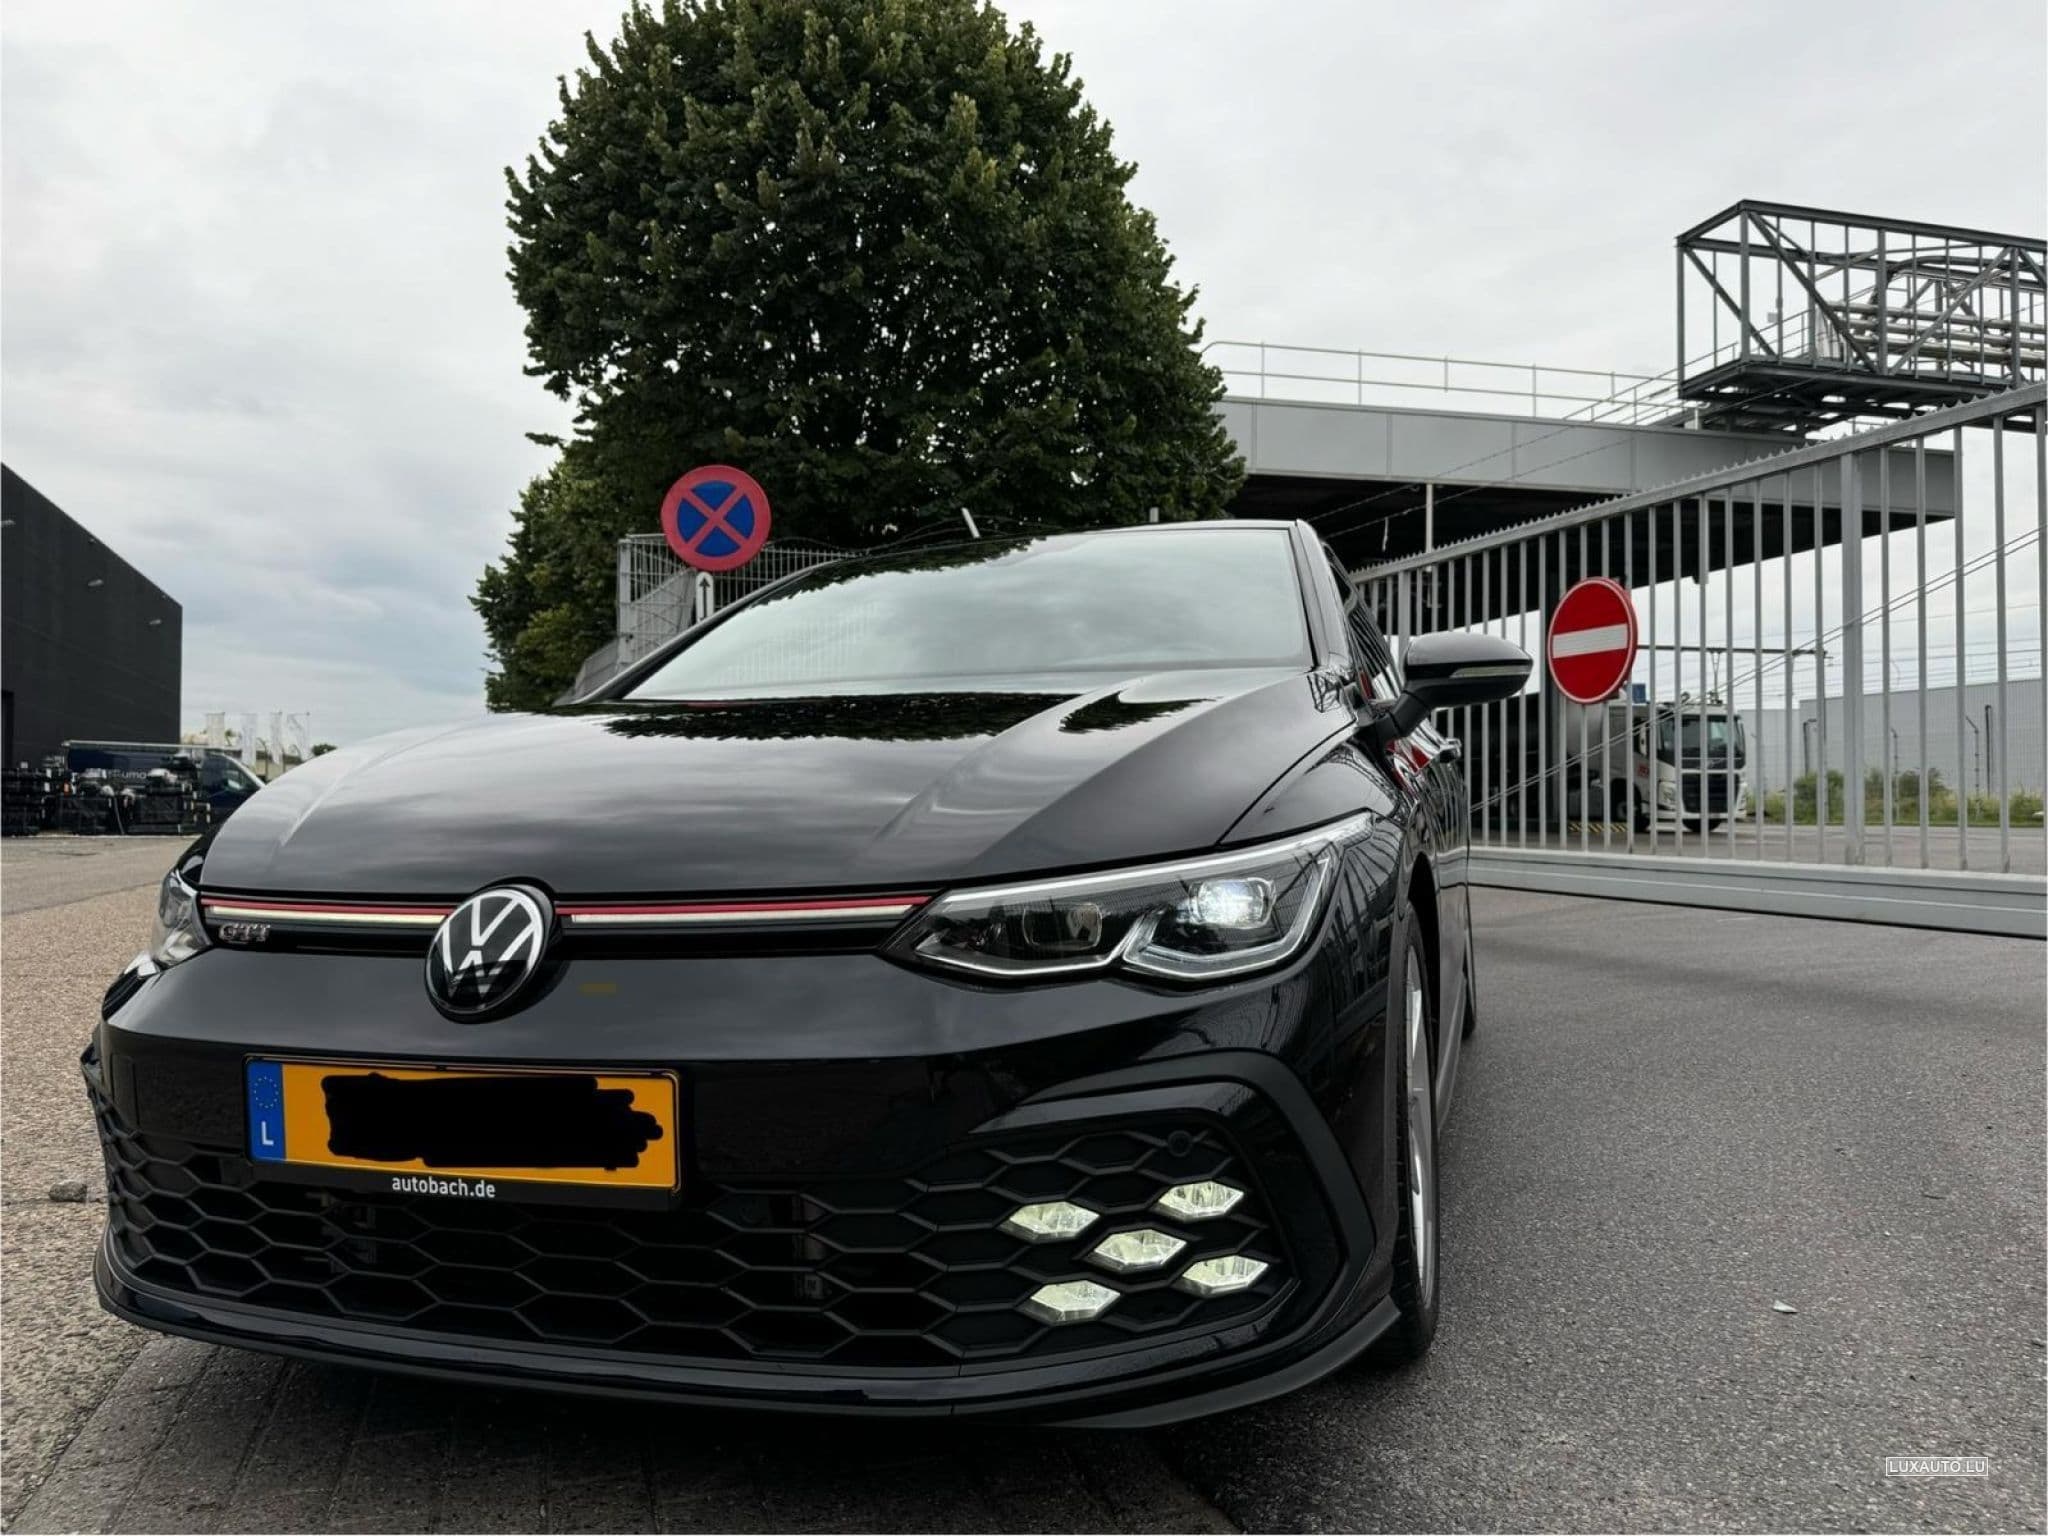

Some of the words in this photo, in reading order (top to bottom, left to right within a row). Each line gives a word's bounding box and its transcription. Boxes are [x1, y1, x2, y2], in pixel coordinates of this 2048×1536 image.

[218, 922, 271, 943] GTI
[261, 1120, 275, 1146] L
[391, 1175, 496, 1199] autobach.de
